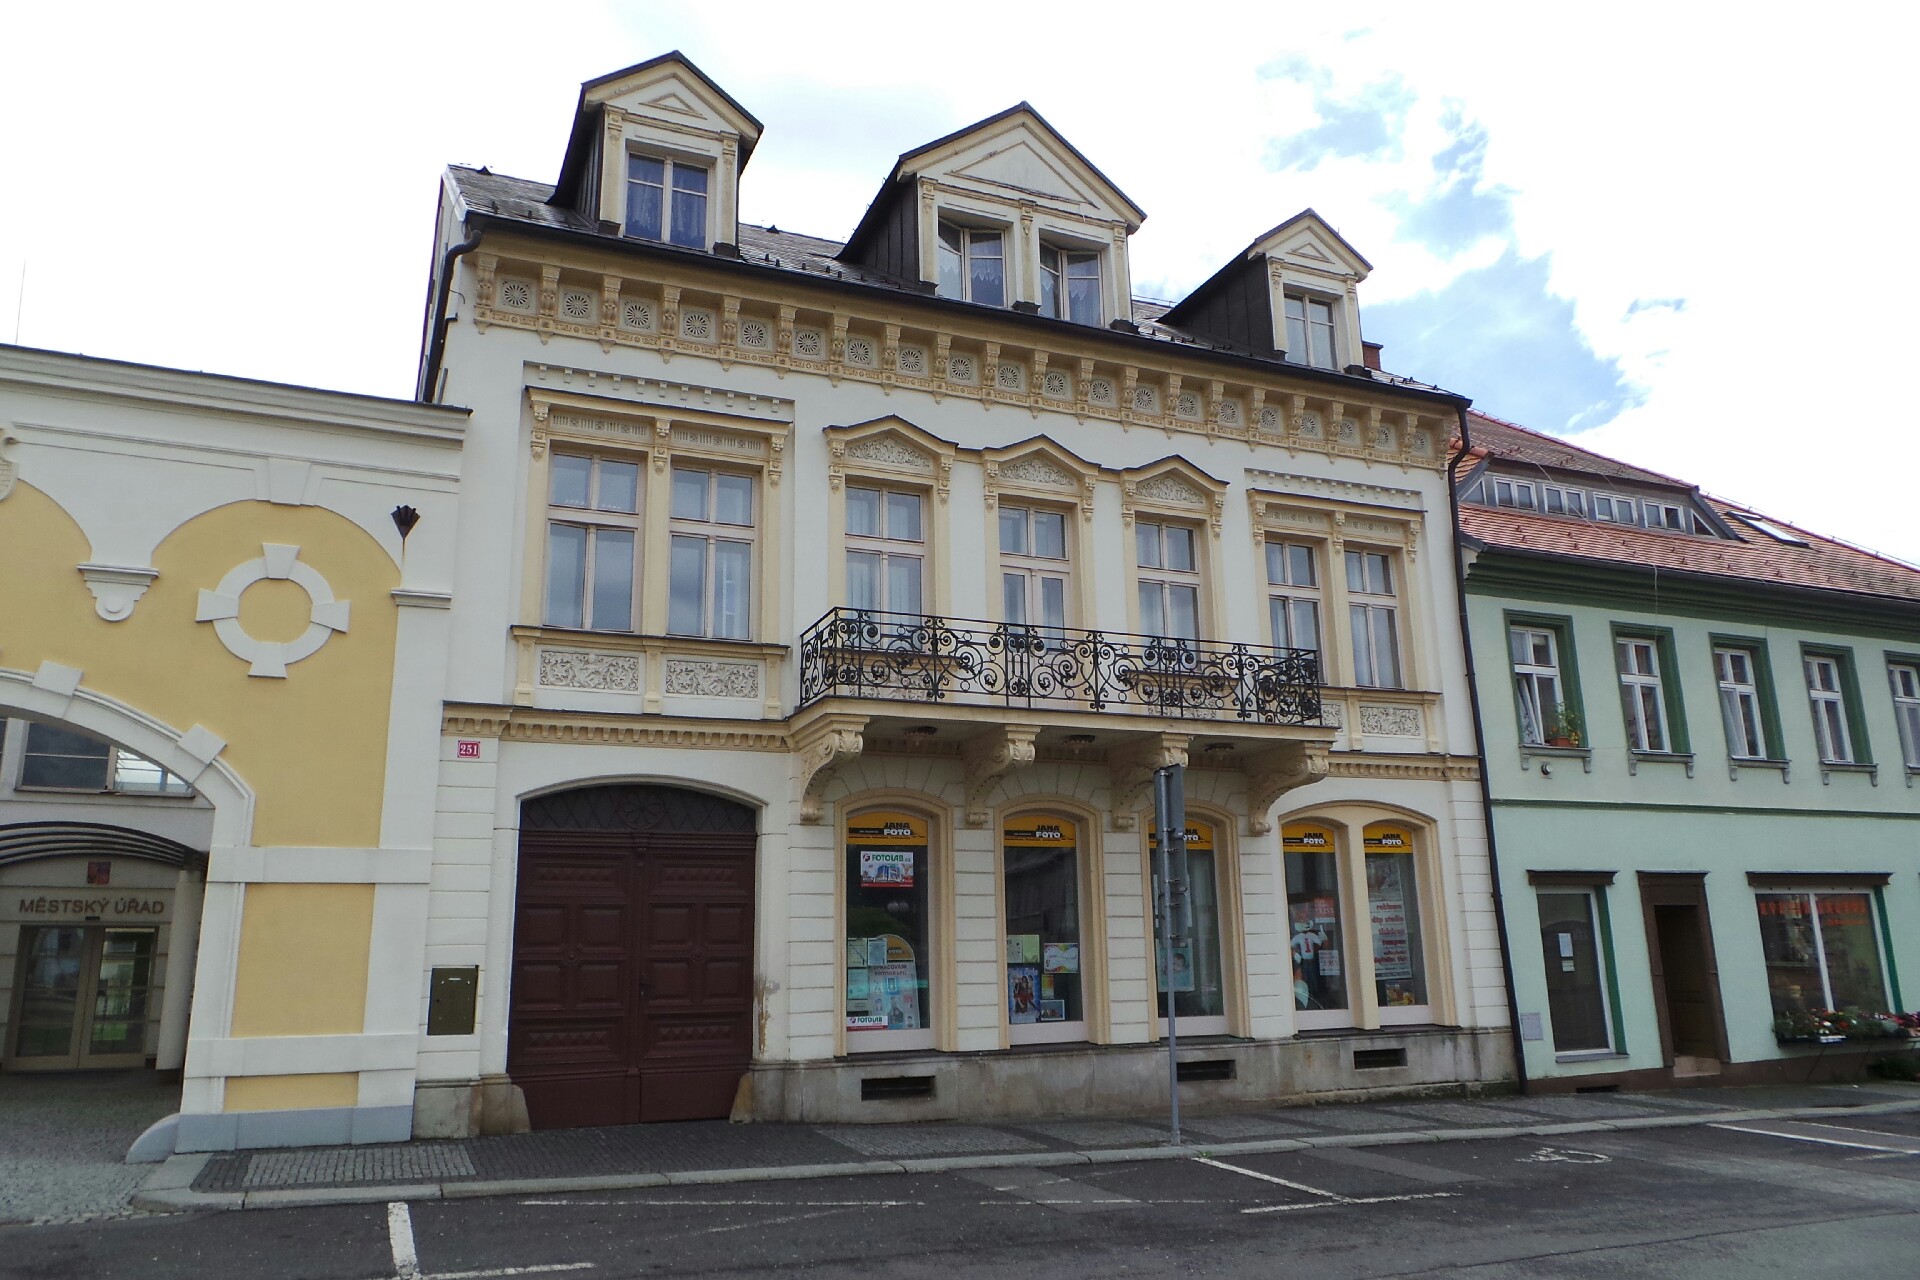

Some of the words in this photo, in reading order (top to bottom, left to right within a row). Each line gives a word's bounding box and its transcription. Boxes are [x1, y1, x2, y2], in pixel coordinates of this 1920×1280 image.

[460, 744, 478, 755] 251
[872, 854, 904, 862] FOTOLAB
[19, 896, 109, 914] MĚSTSKÝ
[114, 897, 165, 914] ÚŘAD
